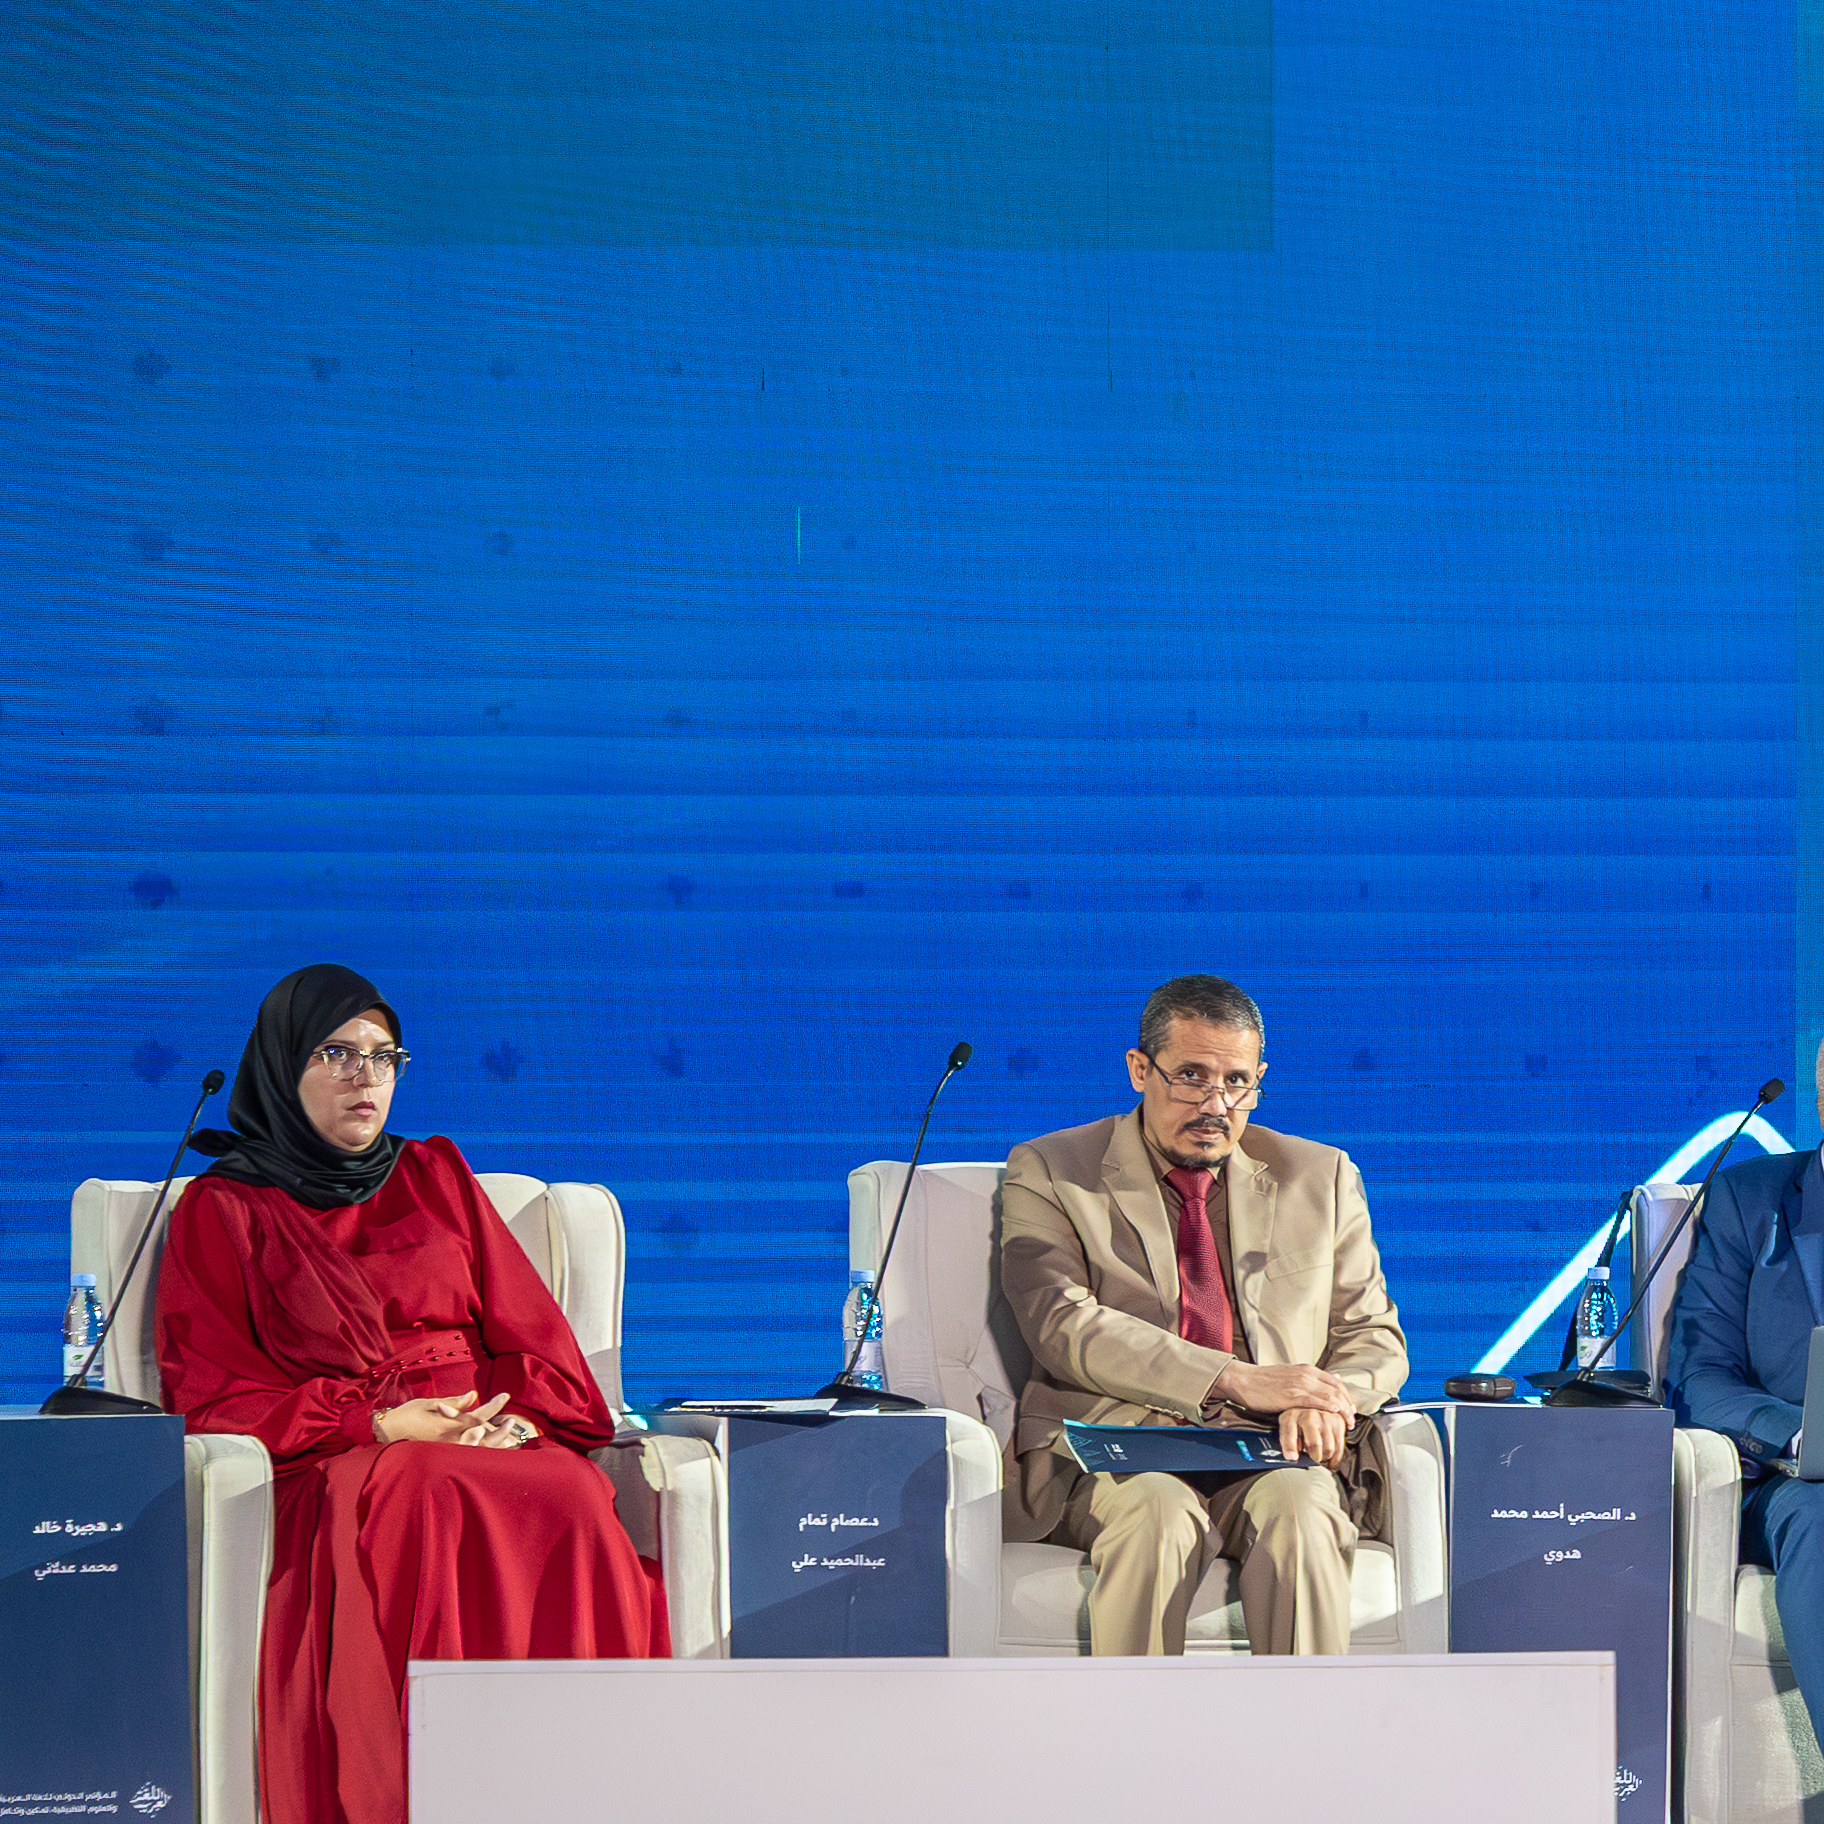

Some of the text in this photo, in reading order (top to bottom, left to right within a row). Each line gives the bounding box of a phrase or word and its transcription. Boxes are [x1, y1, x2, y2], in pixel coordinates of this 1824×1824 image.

[798, 1513, 828, 1532] تمام
[1490, 1502, 1637, 1526] د. الصحبي أحمد محمد
[32, 1520, 62, 1534] خالد
[64, 1519, 108, 1537] هجيرة
[791, 1553, 886, 1573] عبدالحميد علي
[1543, 1549, 1582, 1565] هدوي
[79, 1563, 119, 1573] محمد
